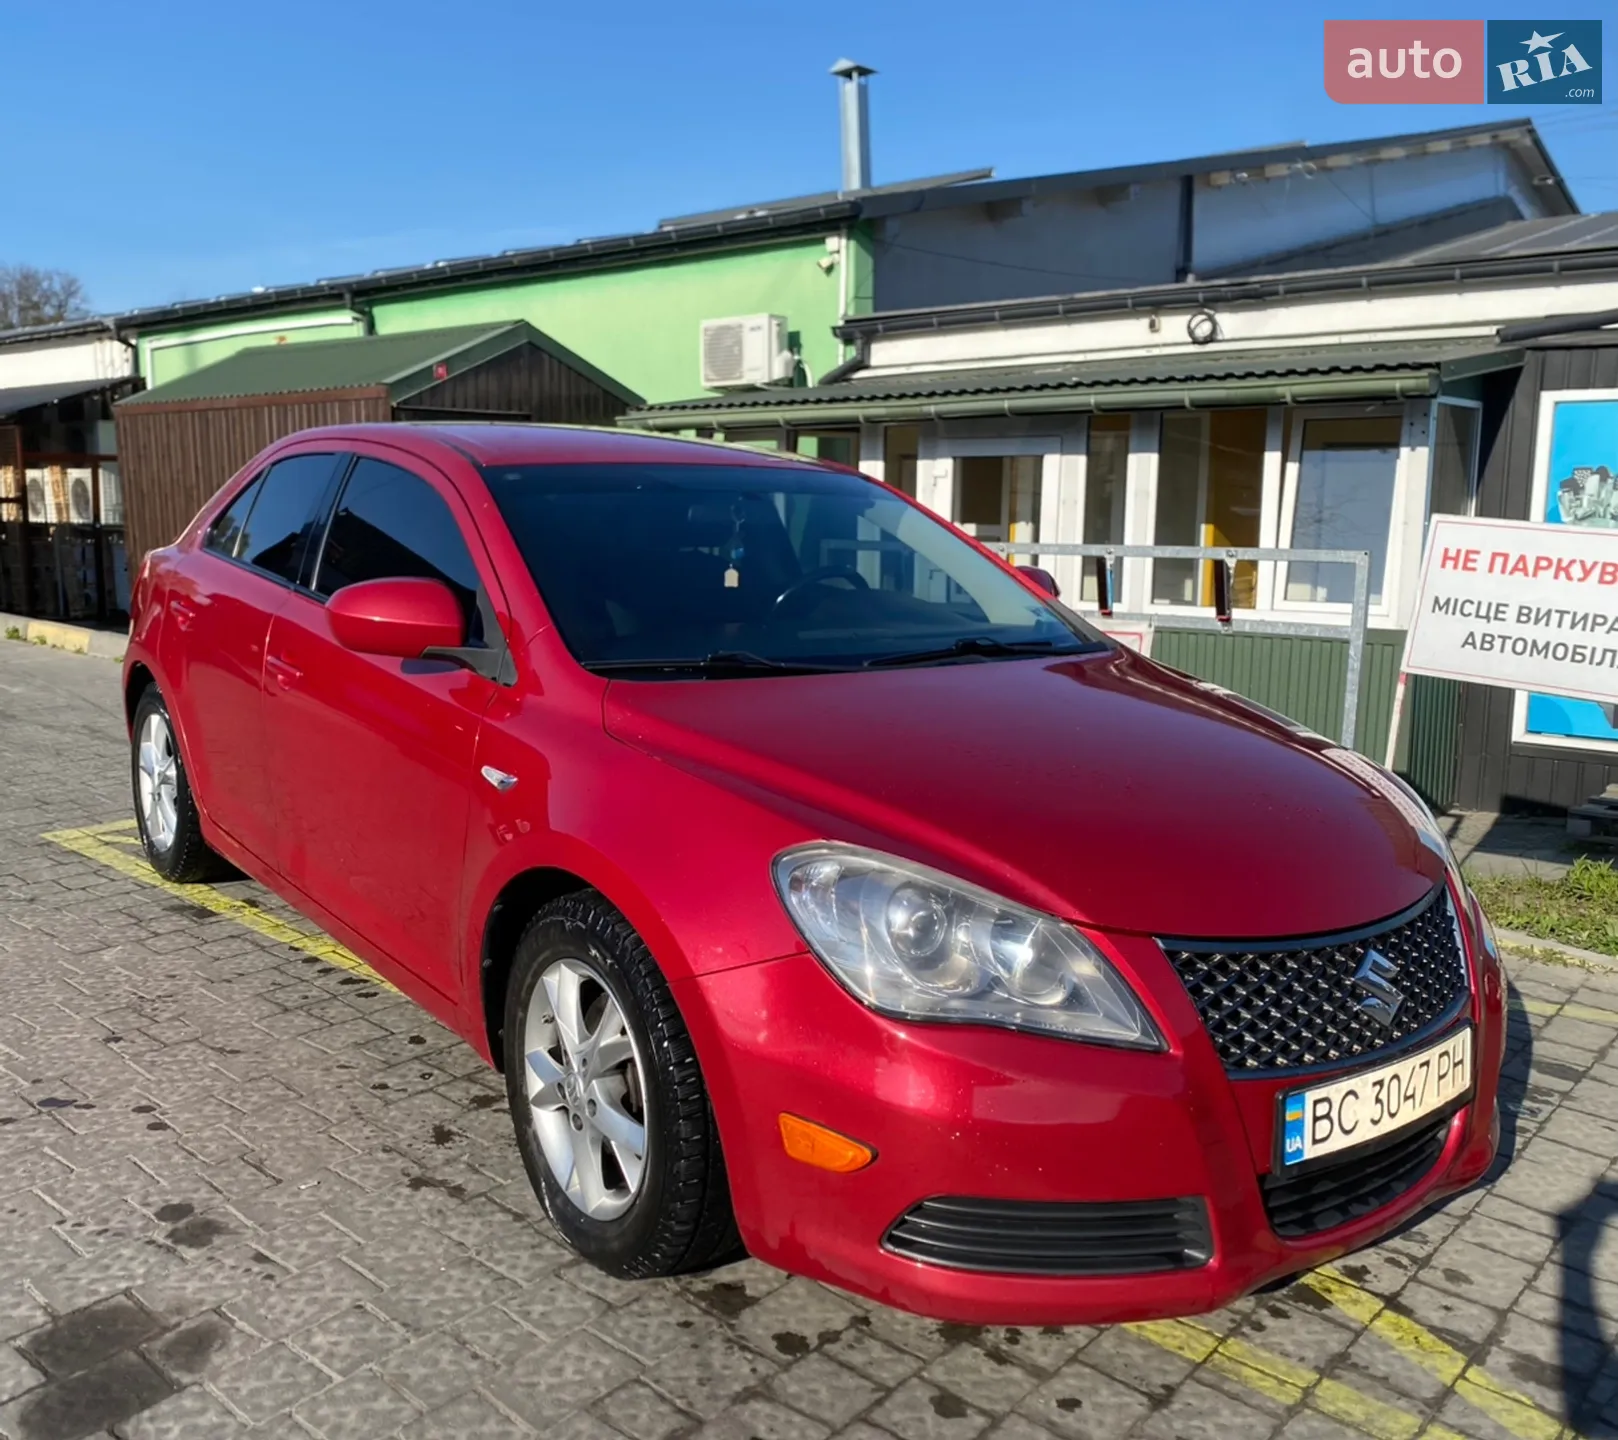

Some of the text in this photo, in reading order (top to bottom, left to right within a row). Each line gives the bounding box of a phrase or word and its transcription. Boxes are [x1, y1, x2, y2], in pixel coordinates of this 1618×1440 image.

[1440, 547, 1618, 586] НЕ ПАРКУВ
[1431, 596, 1510, 623] МІСЦЕ
[1461, 631, 1618, 669] АВТОМОБІЛ
[1311, 1039, 1466, 1146] BC 3047 PH
[1285, 1135, 1303, 1152] UA
